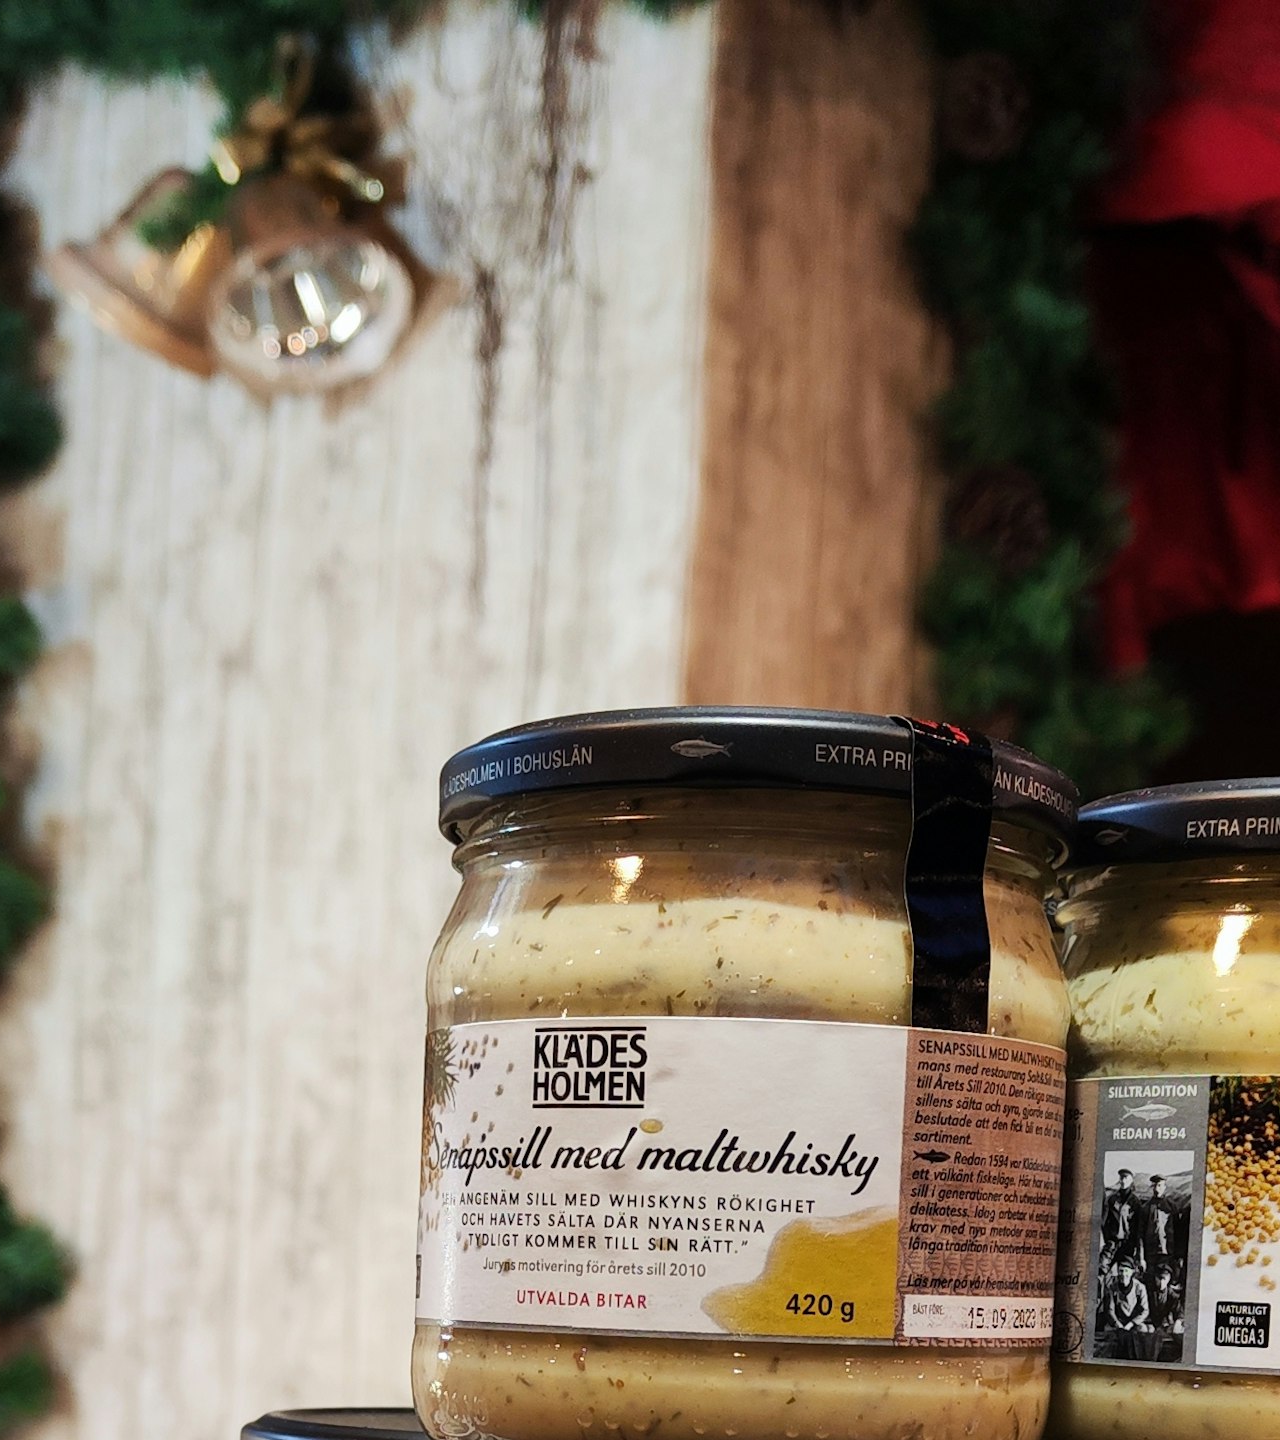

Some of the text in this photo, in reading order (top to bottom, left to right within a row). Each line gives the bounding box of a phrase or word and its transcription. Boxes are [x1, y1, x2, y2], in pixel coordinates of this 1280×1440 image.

[815, 744, 876, 766] EXTRA
[1186, 819, 1239, 838] EXTRA
[534, 1034, 648, 1068] KLÄDES
[919, 1040, 986, 1059] SENAPSSILL
[918, 1061, 950, 1072] mans
[981, 1067, 1025, 1084] restaurang
[533, 1071, 645, 1102] HOLMEN
[917, 1073, 963, 1091] till Årets
[915, 1094, 952, 1107] sillens
[1108, 1084, 1197, 1099] SILLTRADITION
[915, 1111, 972, 1126] beslutade
[1113, 1127, 1186, 1140] REDAN 1594
[552, 1128, 879, 1195] med maltwhisky
[954, 1152, 986, 1166] Redan
[934, 1167, 973, 1183] välkänt
[460, 1189, 519, 1206] ANGENÄM
[527, 1192, 555, 1206] SILL
[565, 1193, 599, 1207] MED
[609, 1194, 707, 1209] WHISKYNS
[717, 1195, 815, 1213] RÖKIGHET
[939, 1188, 1002, 1202] generationer
[462, 1212, 765, 1234] OCH HAVETS SÄLTA DÄR NYANSERNA
[909, 1222, 1022, 1238] krav metoder
[525, 1234, 639, 1250] KOMMER TILL
[945, 1238, 988, 1253] tradition
[518, 1259, 706, 1277] motivering för årets sill 2010
[517, 1291, 647, 1309] UTVALDA BITAR
[786, 1294, 855, 1322] 420 g
[1217, 1304, 1267, 1316] NATURLIGT
[1217, 1327, 1255, 1344] OMEGA
